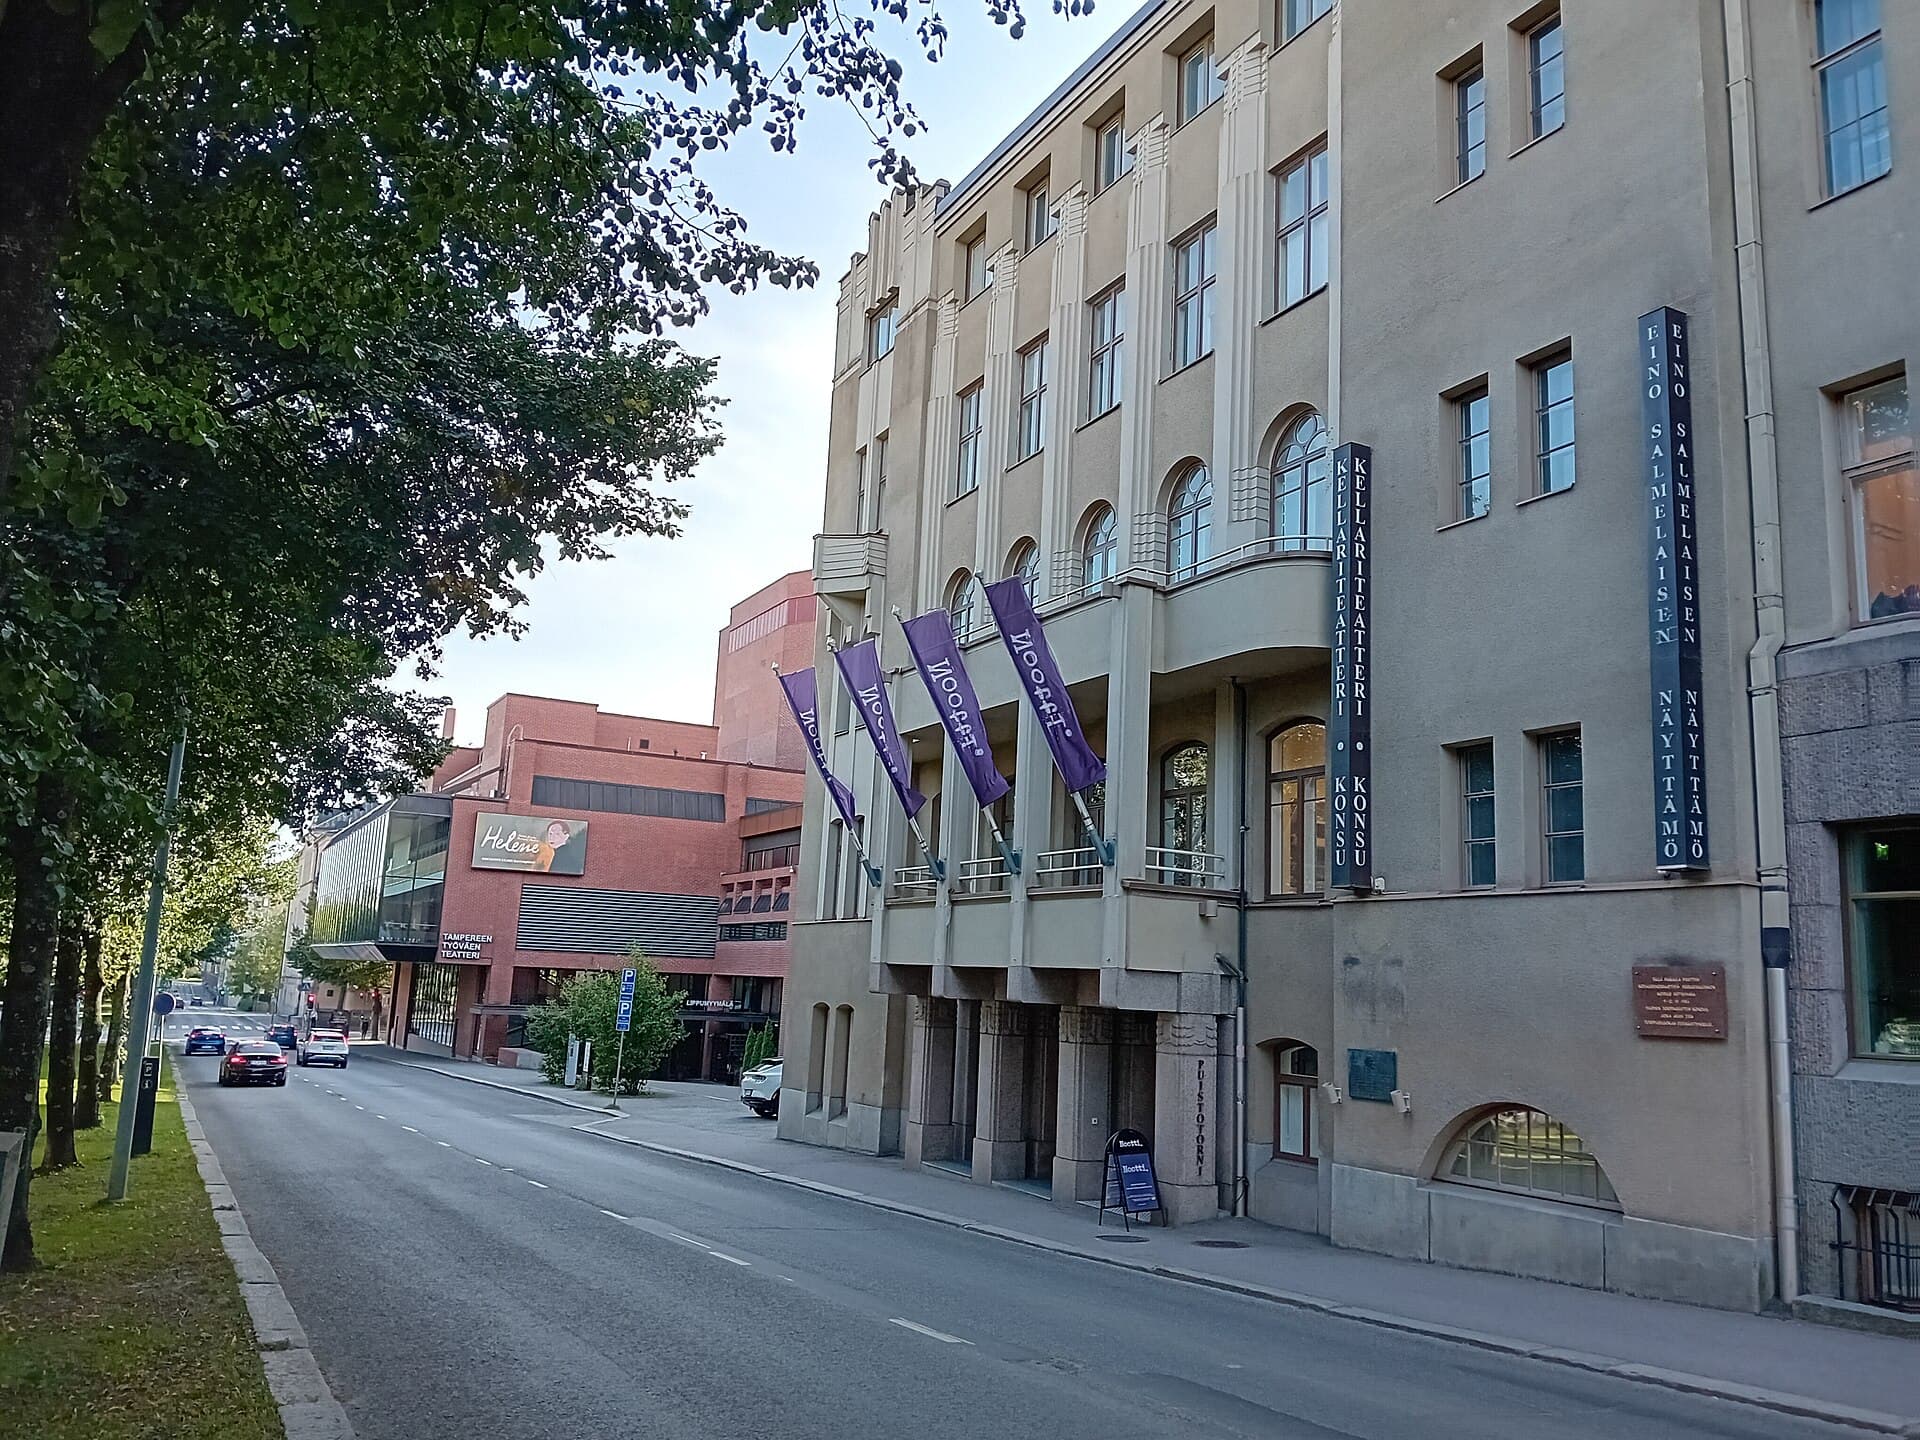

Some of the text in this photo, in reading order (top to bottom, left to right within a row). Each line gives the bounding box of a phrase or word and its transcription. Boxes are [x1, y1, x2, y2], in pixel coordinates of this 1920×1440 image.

[1647, 324, 1679, 858] EINO SALMELAISEN NÄYTTÄMÖ
[1672, 323, 1704, 859] EINO SALMELAISEN NÄYTTÄMÖ
[1334, 457, 1348, 866] KELLARITEATTERI KONSU
[1353, 457, 1367, 867] KELLARITEATTERI KONSU
[481, 825, 540, 854] Helene
[441, 941, 481, 951] TYÖVÄEN
[442, 933, 493, 943] TAMPEREEN
[441, 950, 480, 959] TEATTERI
[624, 970, 634, 982] P
[620, 1002, 630, 1014] P
[1196, 1059, 1205, 1177] PUISTOTORNI
